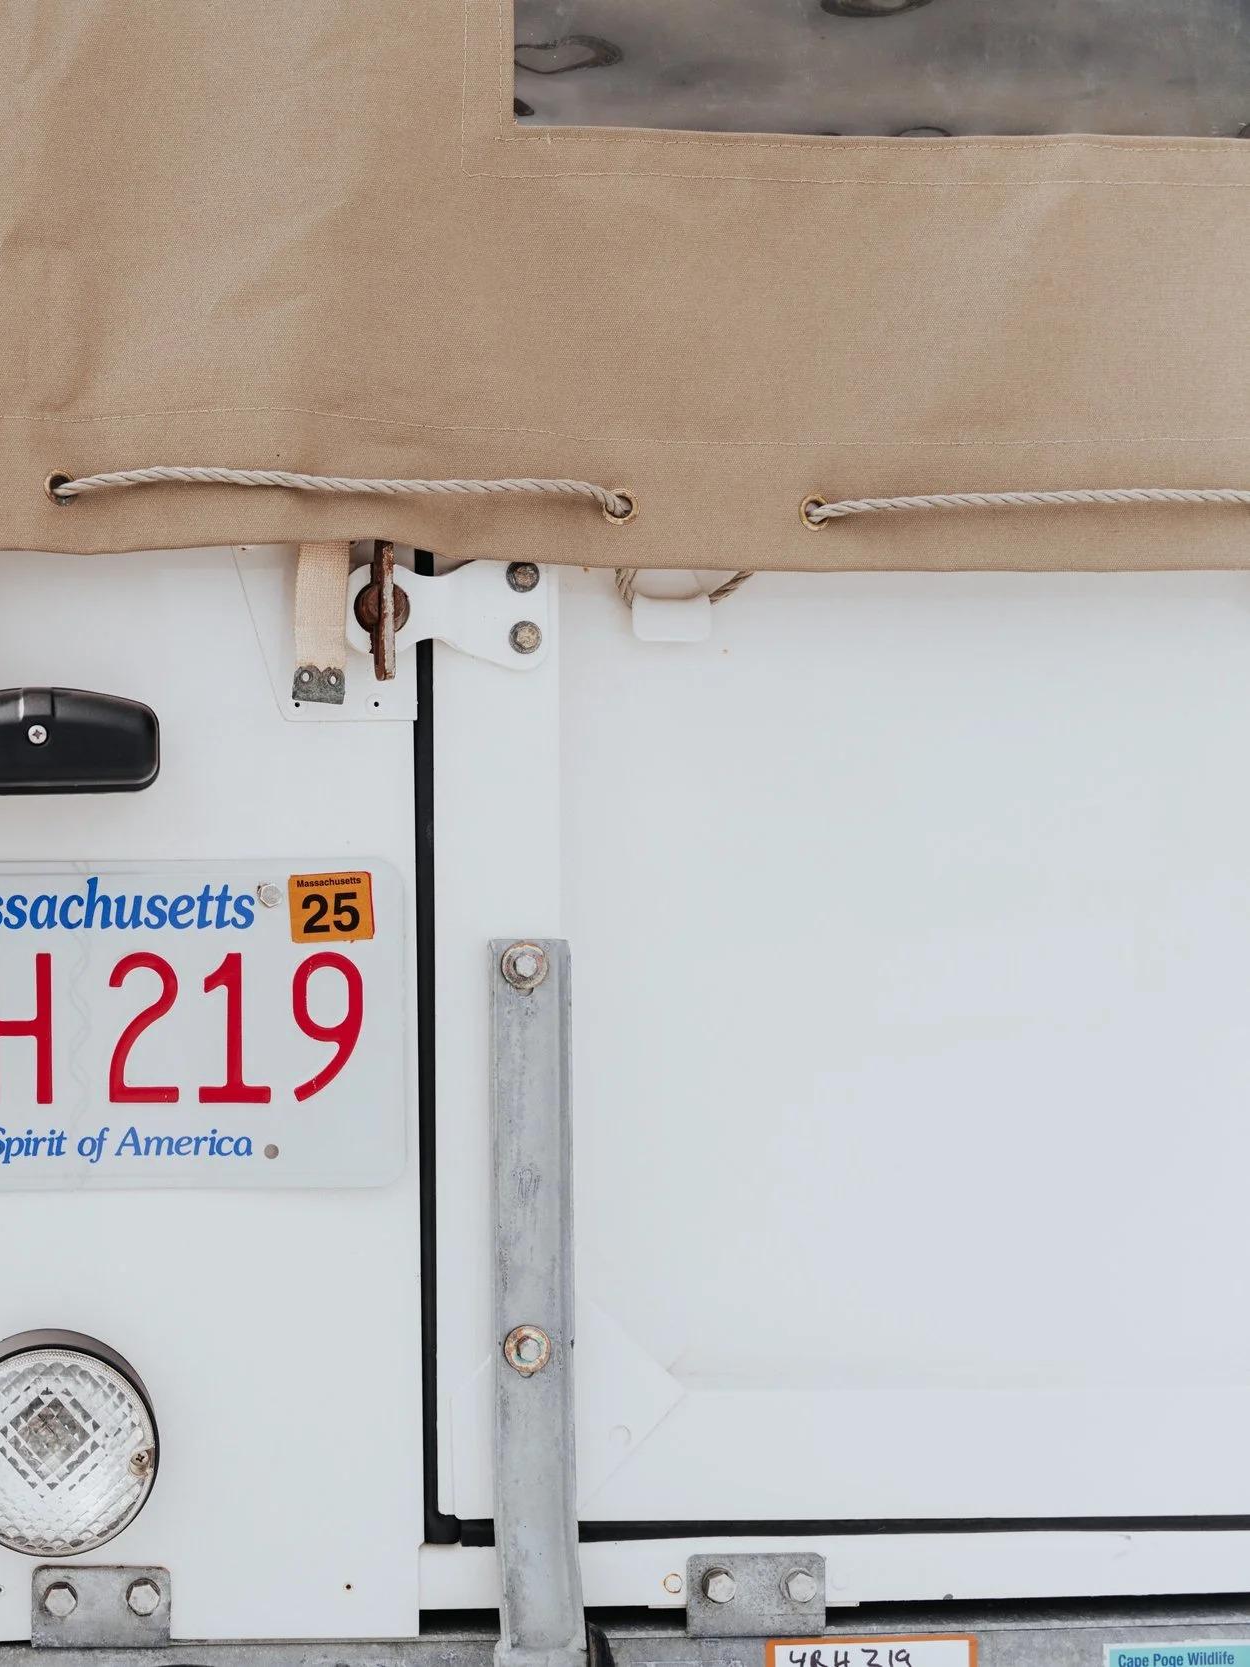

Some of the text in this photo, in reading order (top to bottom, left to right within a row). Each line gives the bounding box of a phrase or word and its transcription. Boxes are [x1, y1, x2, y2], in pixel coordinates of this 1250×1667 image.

[297, 877, 362, 888] Massachusetts
[302, 892, 360, 934] 25
[109, 952, 364, 1104] 219
[77, 1127, 110, 1163] of
[115, 1127, 253, 1157] America
[1118, 1654, 1150, 1667] Cape
[1187, 1651, 1235, 1666] Wildlife
